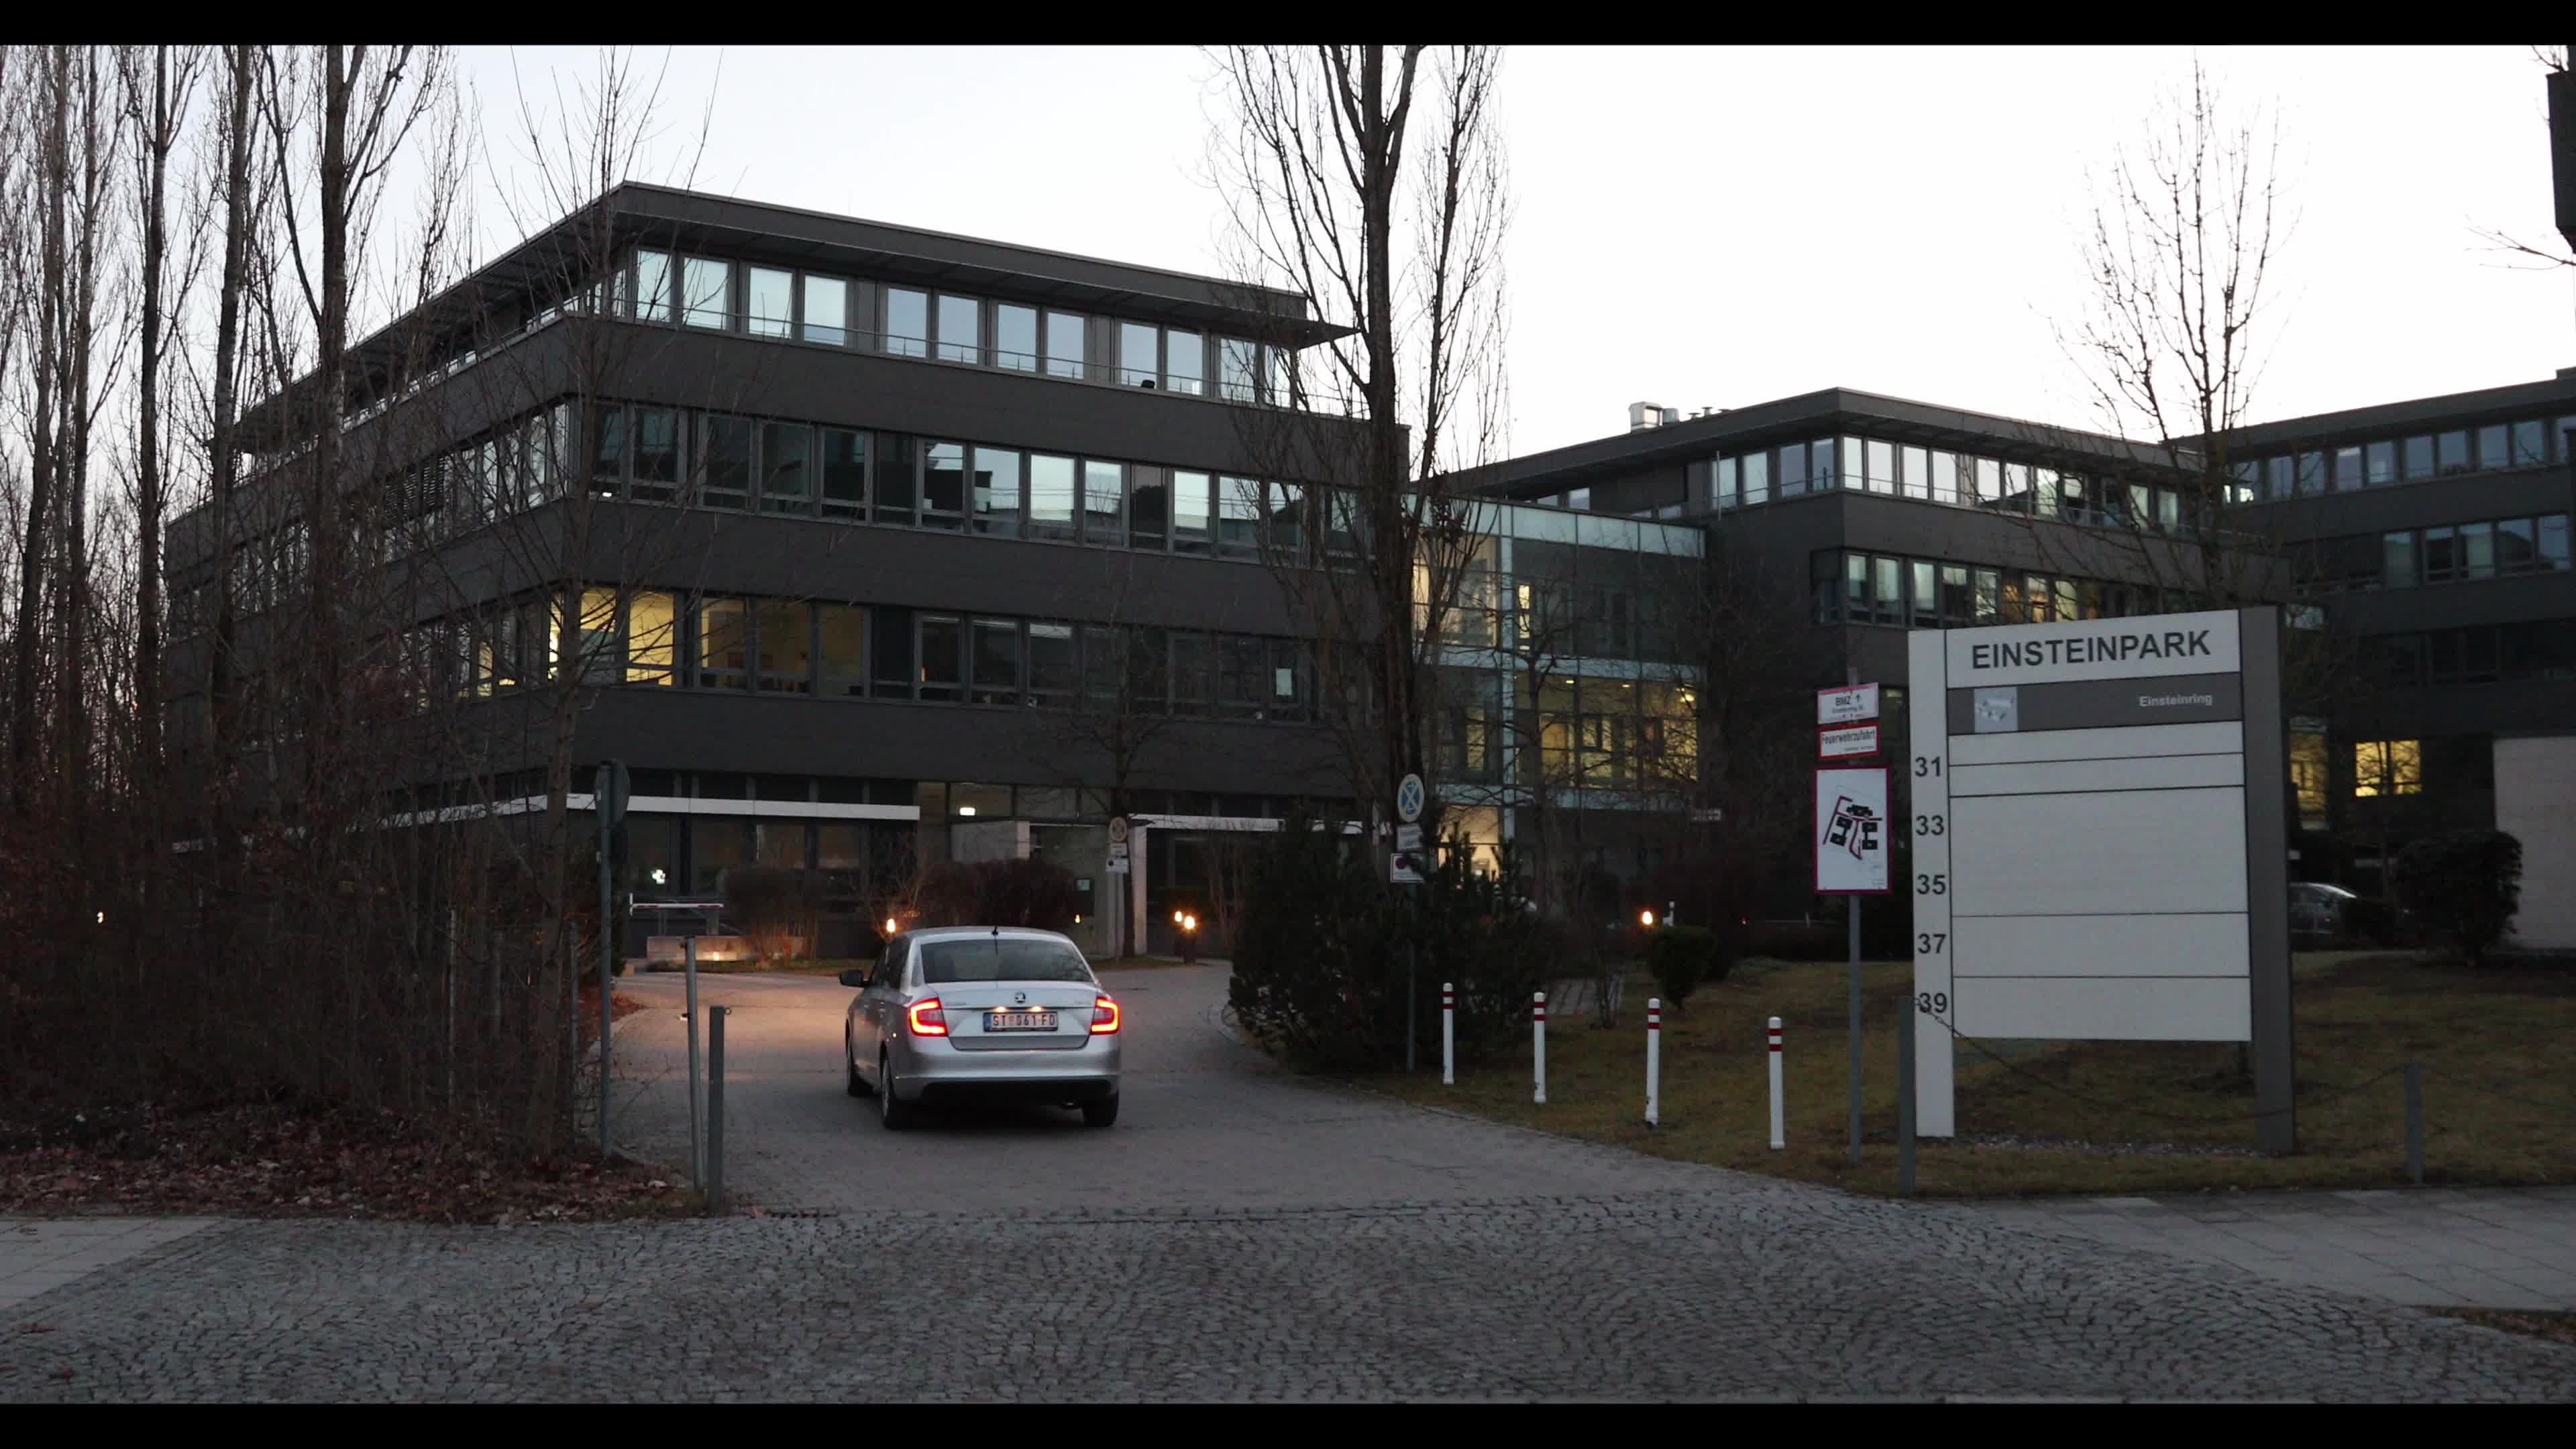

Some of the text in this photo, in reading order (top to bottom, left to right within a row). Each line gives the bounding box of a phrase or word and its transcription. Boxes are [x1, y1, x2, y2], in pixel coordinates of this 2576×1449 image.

[1972, 629, 2212, 669] EINSTEINPARK
[2139, 694, 2213, 707] Einsteinring
[1915, 756, 1941, 777] 31
[1915, 815, 1944, 836] 33
[1917, 874, 1946, 895] 35
[1917, 933, 1947, 954] 37
[1919, 992, 1947, 1014] 39
